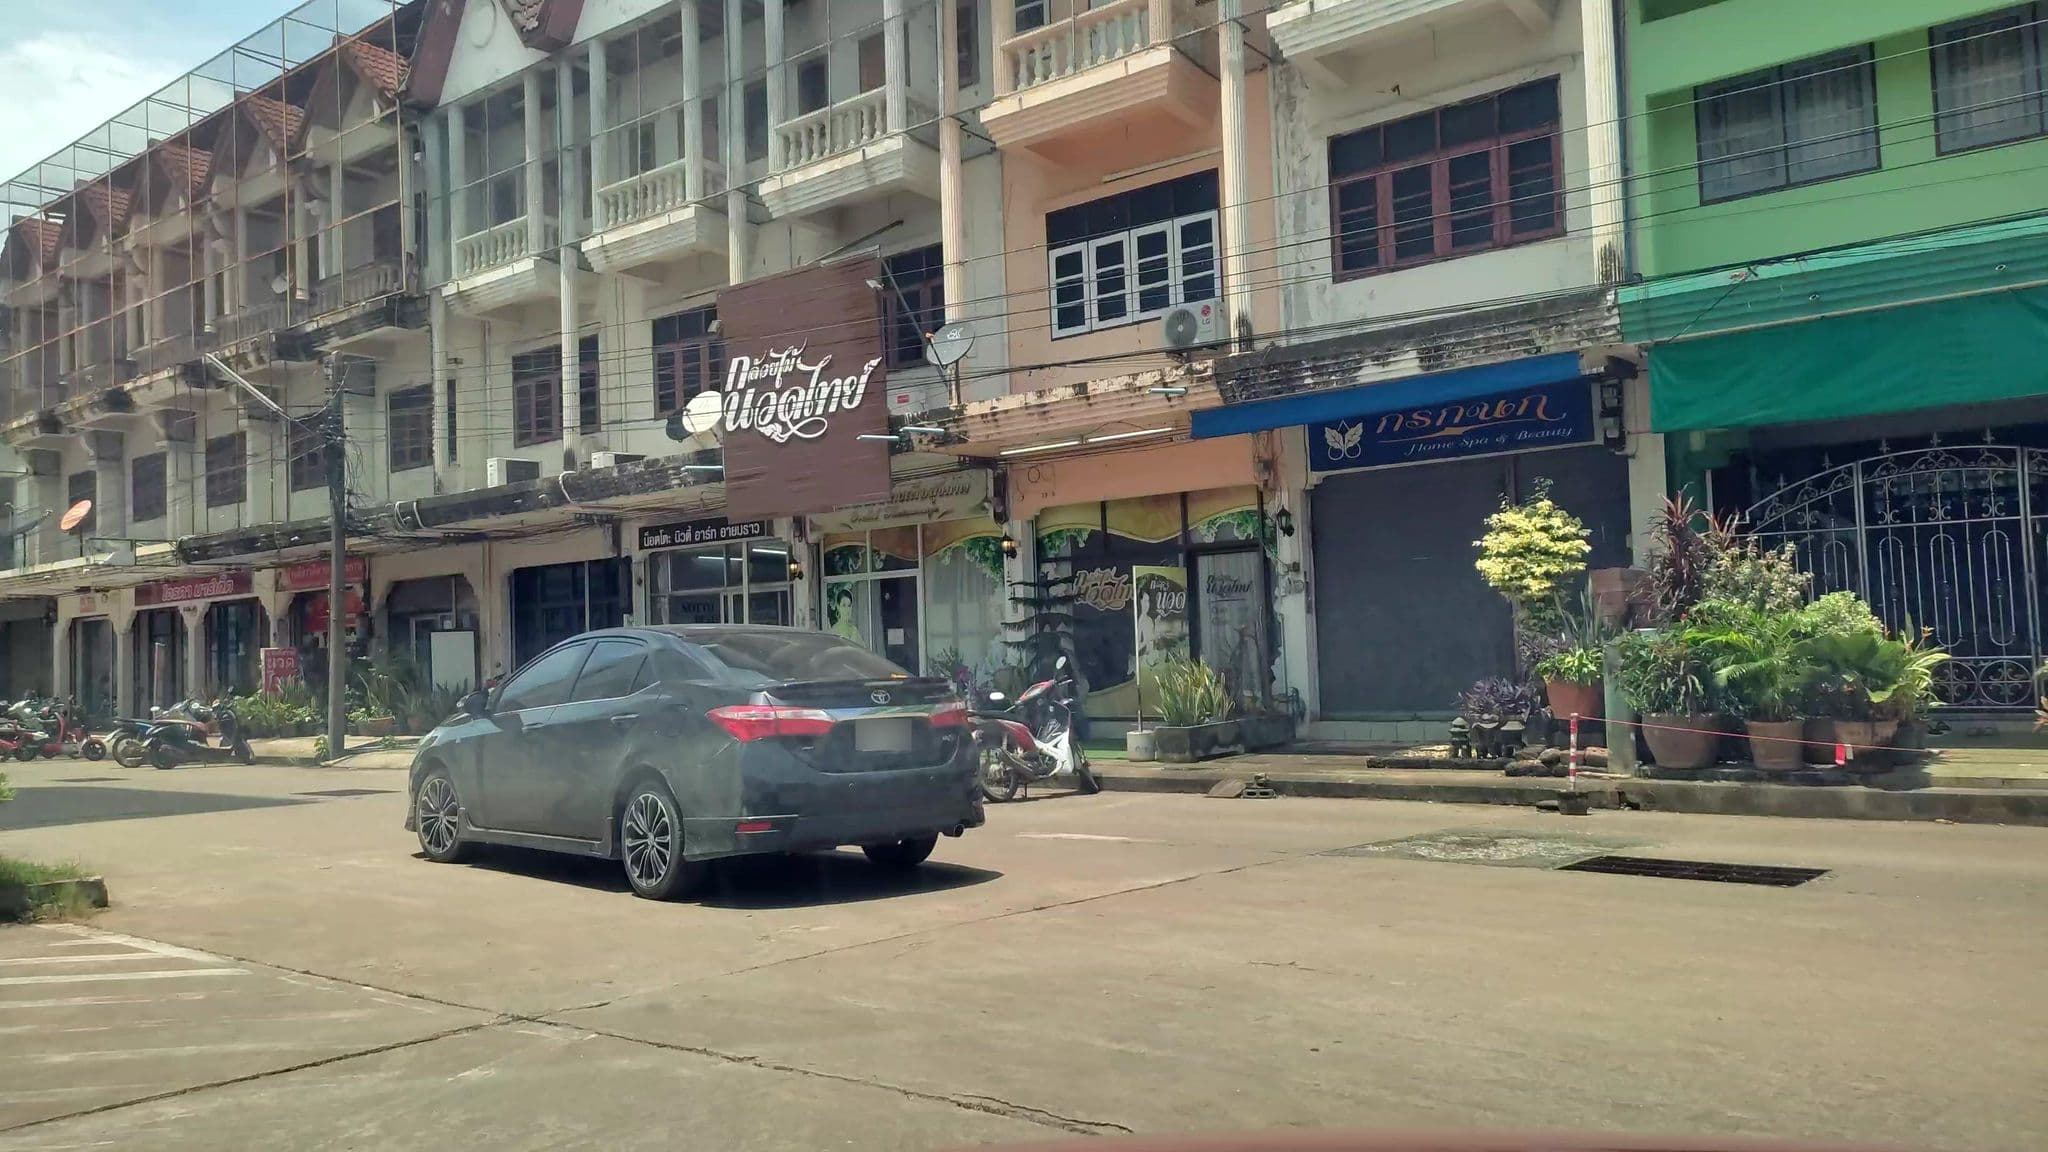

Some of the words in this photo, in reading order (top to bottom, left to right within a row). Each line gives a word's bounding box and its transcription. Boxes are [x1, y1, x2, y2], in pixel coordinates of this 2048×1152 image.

[1404, 440, 1455, 456] Home
[1461, 436, 1488, 449] Spa
[1495, 433, 1507, 444] &
[1517, 427, 1573, 441] Beauty
